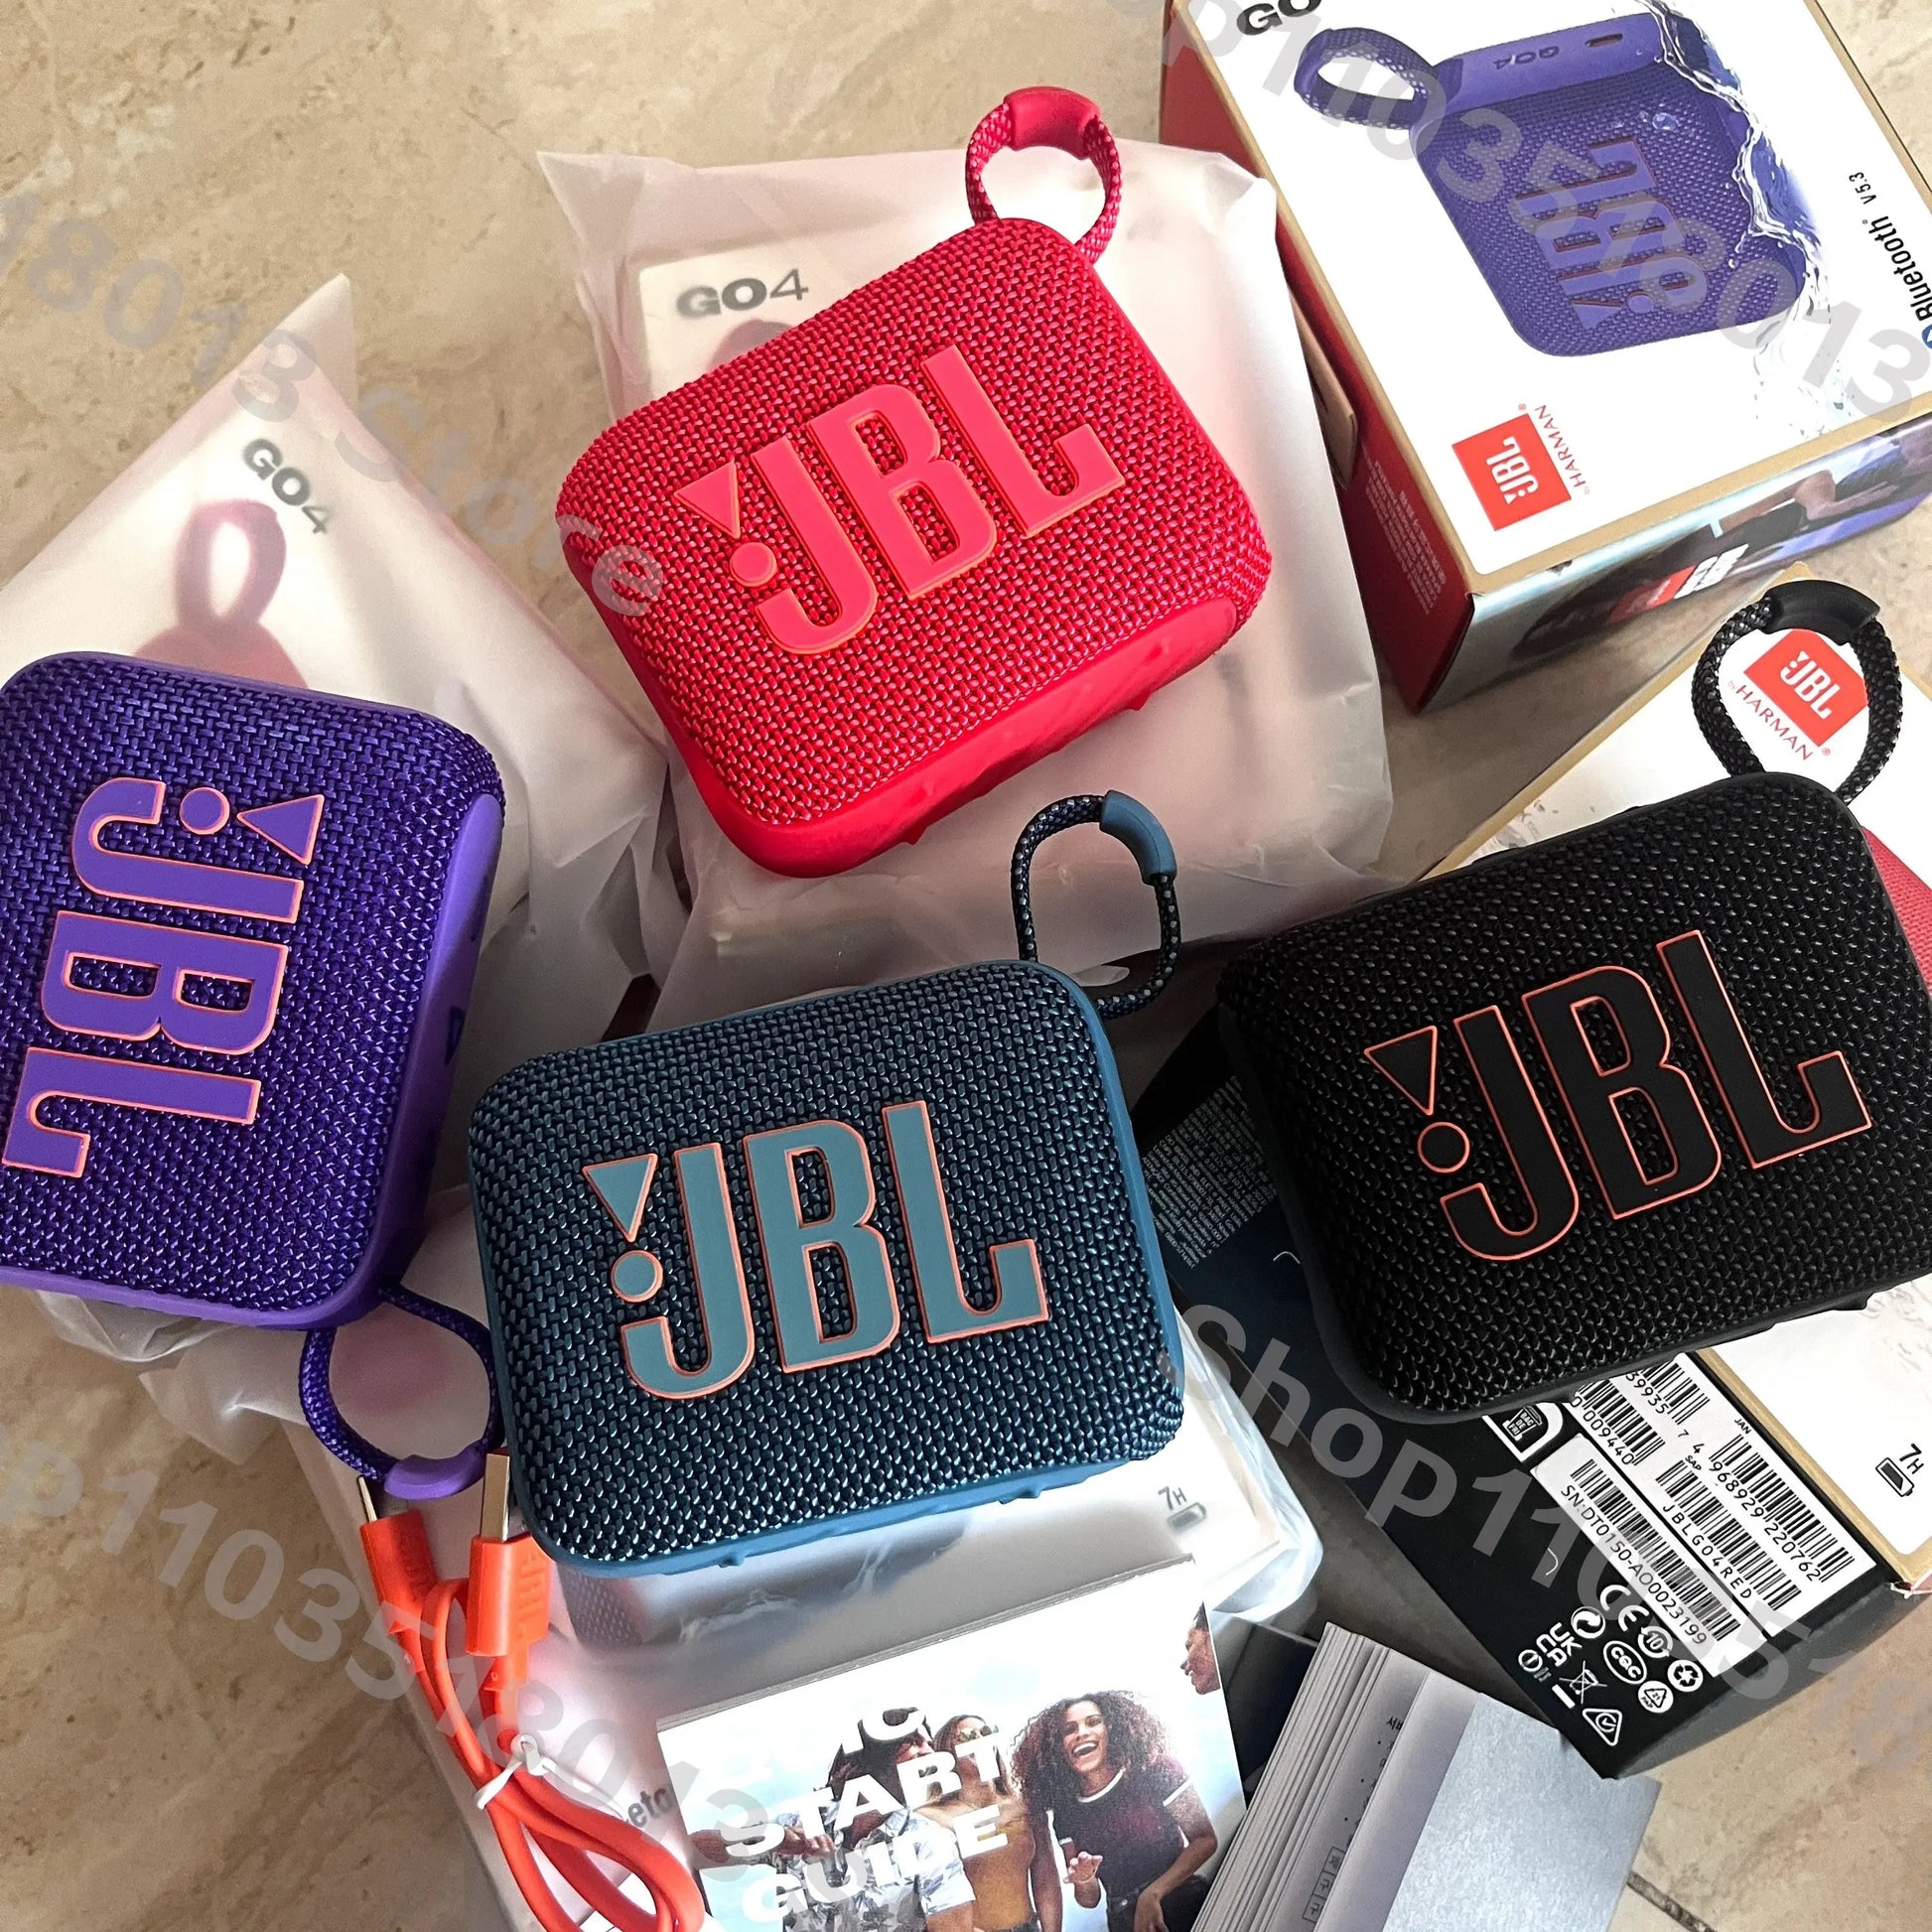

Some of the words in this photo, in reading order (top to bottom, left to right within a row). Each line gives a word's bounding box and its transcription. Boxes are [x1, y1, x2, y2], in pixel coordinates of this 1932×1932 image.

[1515, 135, 1710, 300] JBL
[676, 268, 809, 321] GO4
[1867, 215, 1932, 321] Bluetooth
[241, 438, 332, 536] GO4
[1485, 436, 1539, 495] JBL
[1534, 404, 1587, 488] HARMAN
[744, 345, 1127, 656] JBL
[1735, 683, 1814, 761] HARMAN
[1779, 658, 1842, 721] JBL
[1, 776, 306, 1178] JBL
[1440, 929, 1872, 1262] JBL
[621, 1099, 1050, 1400] JBL
[1583, 1410, 1636, 1466] 009440
[1684, 1453, 1703, 1471] SAP
[1734, 1417, 1752, 1436] JAN
[1898, 1442, 1925, 1475] 7H
[1157, 1485, 1187, 1511] 7H
[1692, 1443, 1705, 1454] 4
[1709, 1460, 1765, 1519] 968929
[1764, 1521, 1822, 1583] 220762
[1644, 1631, 1663, 1650] 10
[724, 1734, 1004, 1858] START
[742, 1804, 1009, 1923] GUIDE
